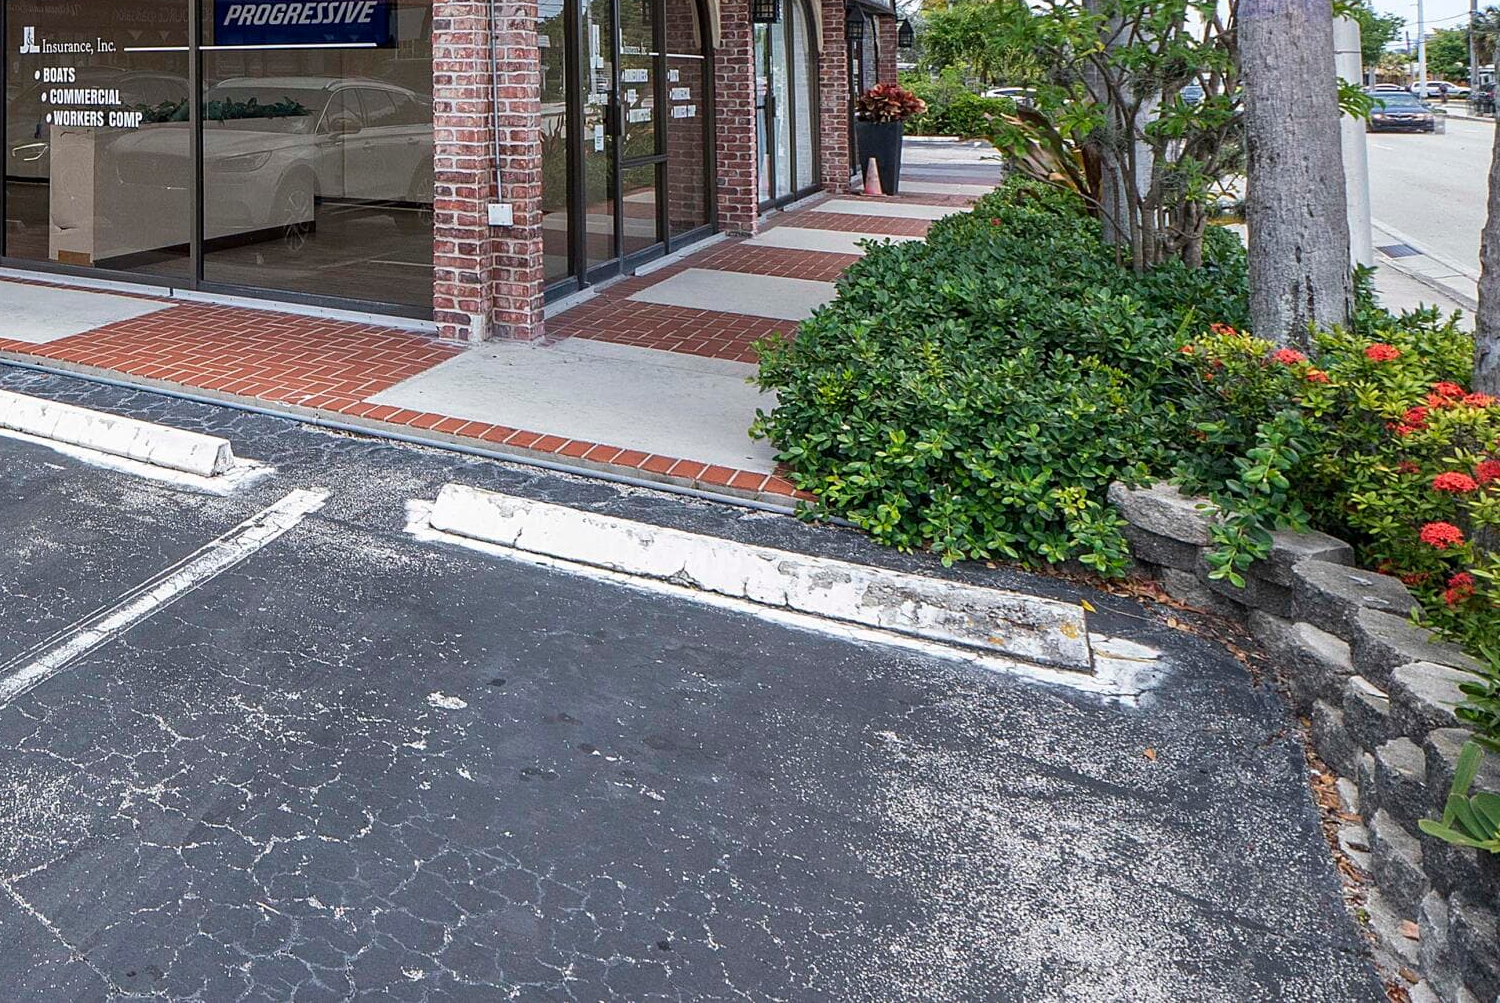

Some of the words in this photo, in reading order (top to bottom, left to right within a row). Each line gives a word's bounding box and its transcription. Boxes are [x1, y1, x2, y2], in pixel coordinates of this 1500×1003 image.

[223, 1, 378, 26] PROGRESSIVE
[42, 38, 94, 55] Insurance,
[97, 37, 117, 53] Inc.
[43, 67, 76, 83] BOATS
[50, 88, 122, 105] COMMERCIAL
[53, 110, 105, 127] WORKERS
[108, 111, 143, 128] COMP
